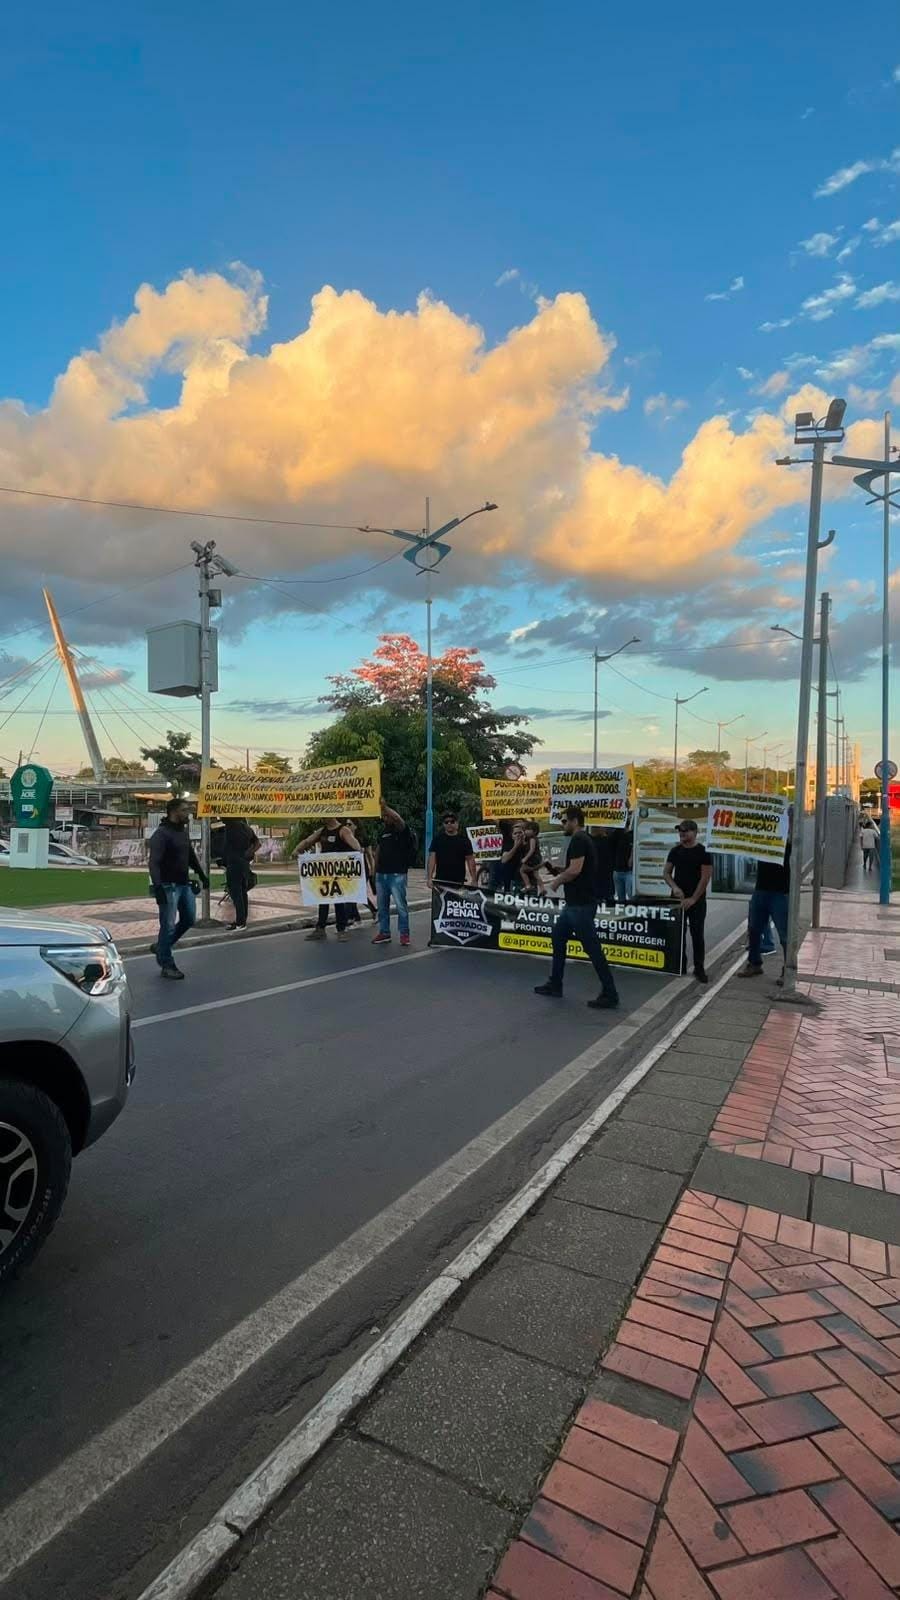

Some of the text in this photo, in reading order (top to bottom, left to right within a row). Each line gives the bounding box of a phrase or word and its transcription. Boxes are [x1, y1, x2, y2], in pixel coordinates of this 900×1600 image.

[286, 773, 310, 784] PEDE
[311, 766, 358, 782] SOCORRO
[556, 770, 624, 782] FALTA DE PESSOAL:
[319, 777, 365, 789] ESPERANDO
[366, 777, 372, 788] A
[552, 784, 574, 794] RISCO
[574, 783, 593, 794] PARA
[345, 788, 375, 799] HOMENS
[574, 798, 609, 808] SOMENTE
[609, 799, 624, 809] 117
[734, 811, 780, 823] AGUARDANDO
[300, 857, 362, 878] CONVOCAÇÃO
[319, 877, 342, 896] JÁ
[446, 900, 480, 910] POLÍCIA
[446, 908, 480, 918] PENAL
[517, 908, 549, 923] Acre
[614, 903, 676, 921] FORTE.
[439, 920, 488, 933] APROVADOS
[515, 922, 553, 933] PRONTOS
[608, 932, 615, 940] E
[616, 933, 666, 946] PROTEGER!
